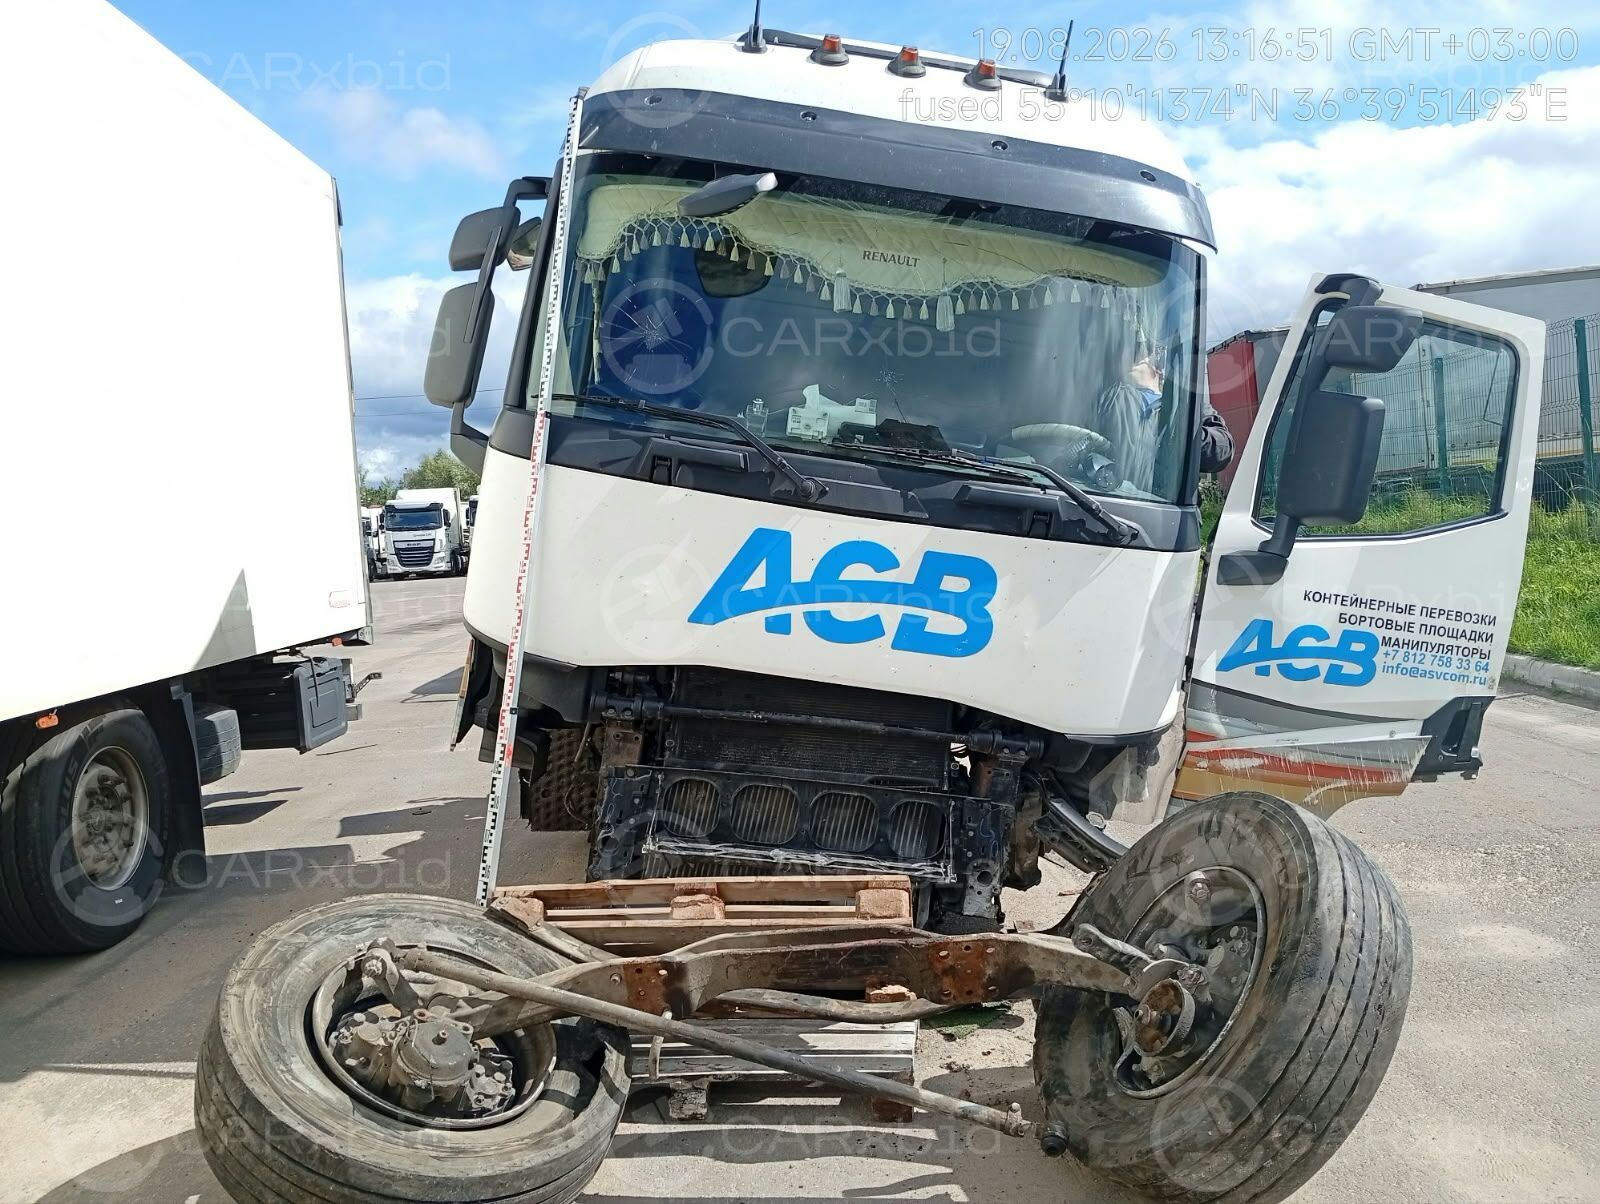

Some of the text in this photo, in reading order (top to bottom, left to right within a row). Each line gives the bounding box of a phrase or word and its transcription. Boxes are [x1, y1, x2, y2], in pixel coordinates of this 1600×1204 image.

[862, 250, 921, 268] RENAULT
[1303, 590, 1497, 627] КОНТЕЙНЕРНЫЕ ПЕРЕВОЗКИ
[1338, 612, 1494, 644] БОРТОВЫЕ ПЛОЩАДКИ
[1381, 636, 1491, 661] МАНИПУЛЯТОРЫ
[1383, 649, 1490, 673] +7 812 758 33 64
[1382, 662, 1488, 686] info@asvcom.ru
